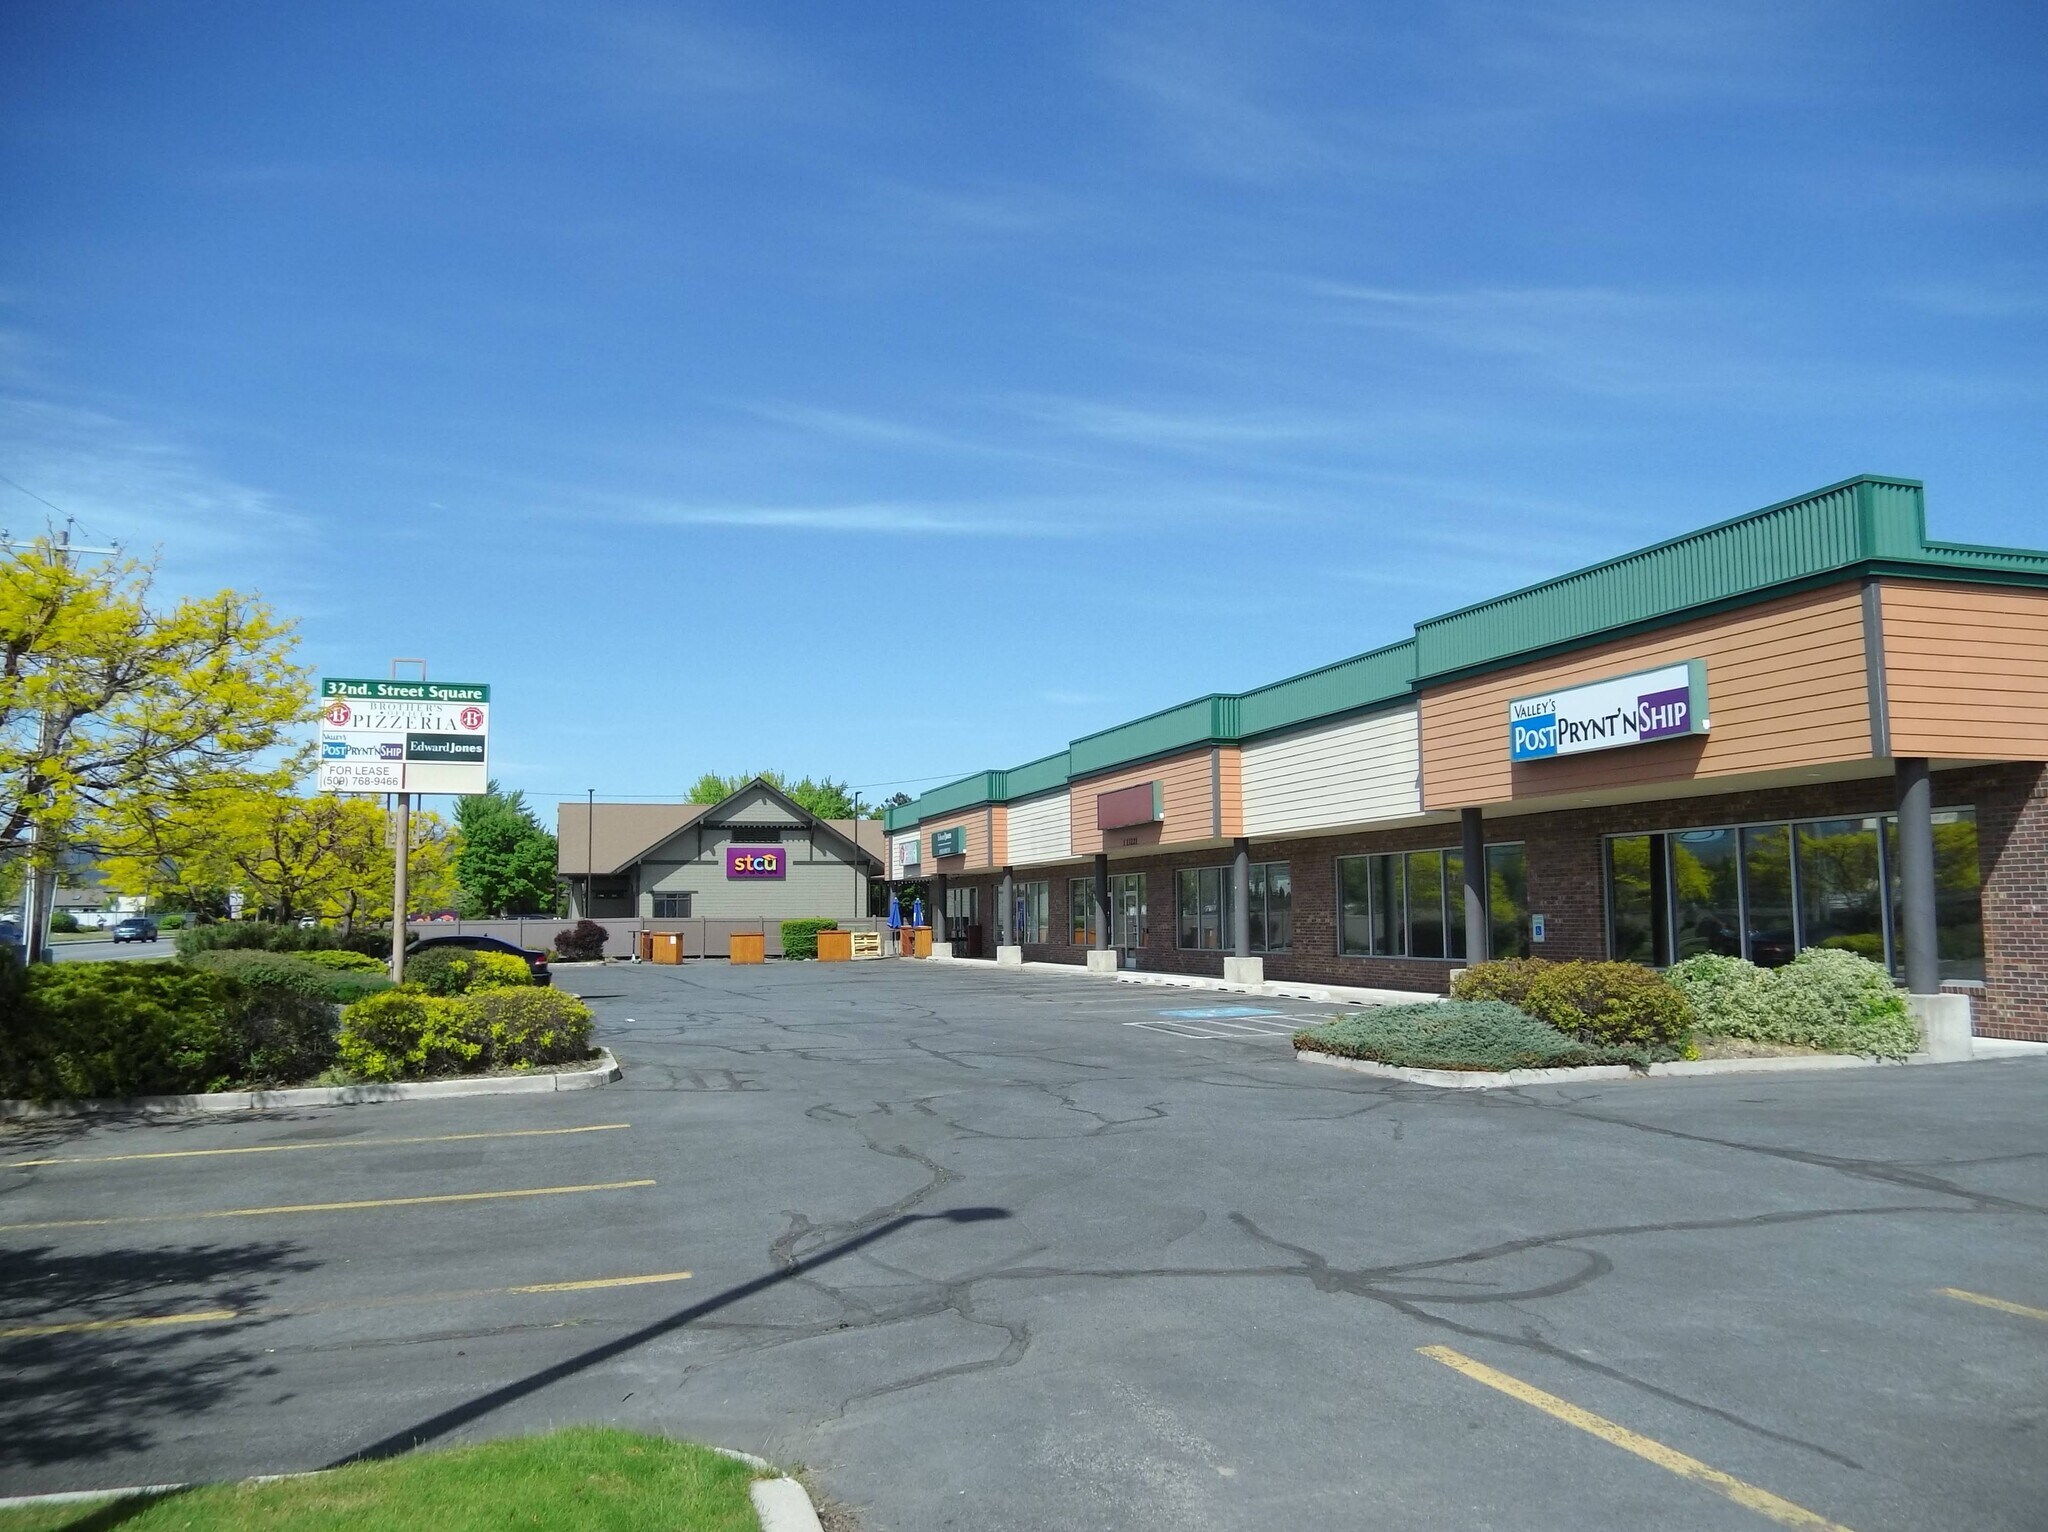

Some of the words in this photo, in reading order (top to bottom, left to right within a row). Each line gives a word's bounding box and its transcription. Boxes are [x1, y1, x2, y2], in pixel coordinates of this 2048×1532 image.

[328, 682, 372, 696] 32nd.
[377, 684, 424, 697] Street
[429, 686, 483, 701] Square
[370, 702, 443, 712] BROTHER'S
[1514, 698, 1556, 718] VALLEY'S
[353, 714, 458, 730] PIZZERIA
[1515, 725, 1557, 753] POST
[1639, 701, 1687, 732] SHIP
[322, 744, 346, 755] POST
[380, 745, 402, 757] SHIP
[329, 766, 352, 775] FOR
[355, 766, 390, 776] LEASE
[352, 777, 399, 786] 768-9466
